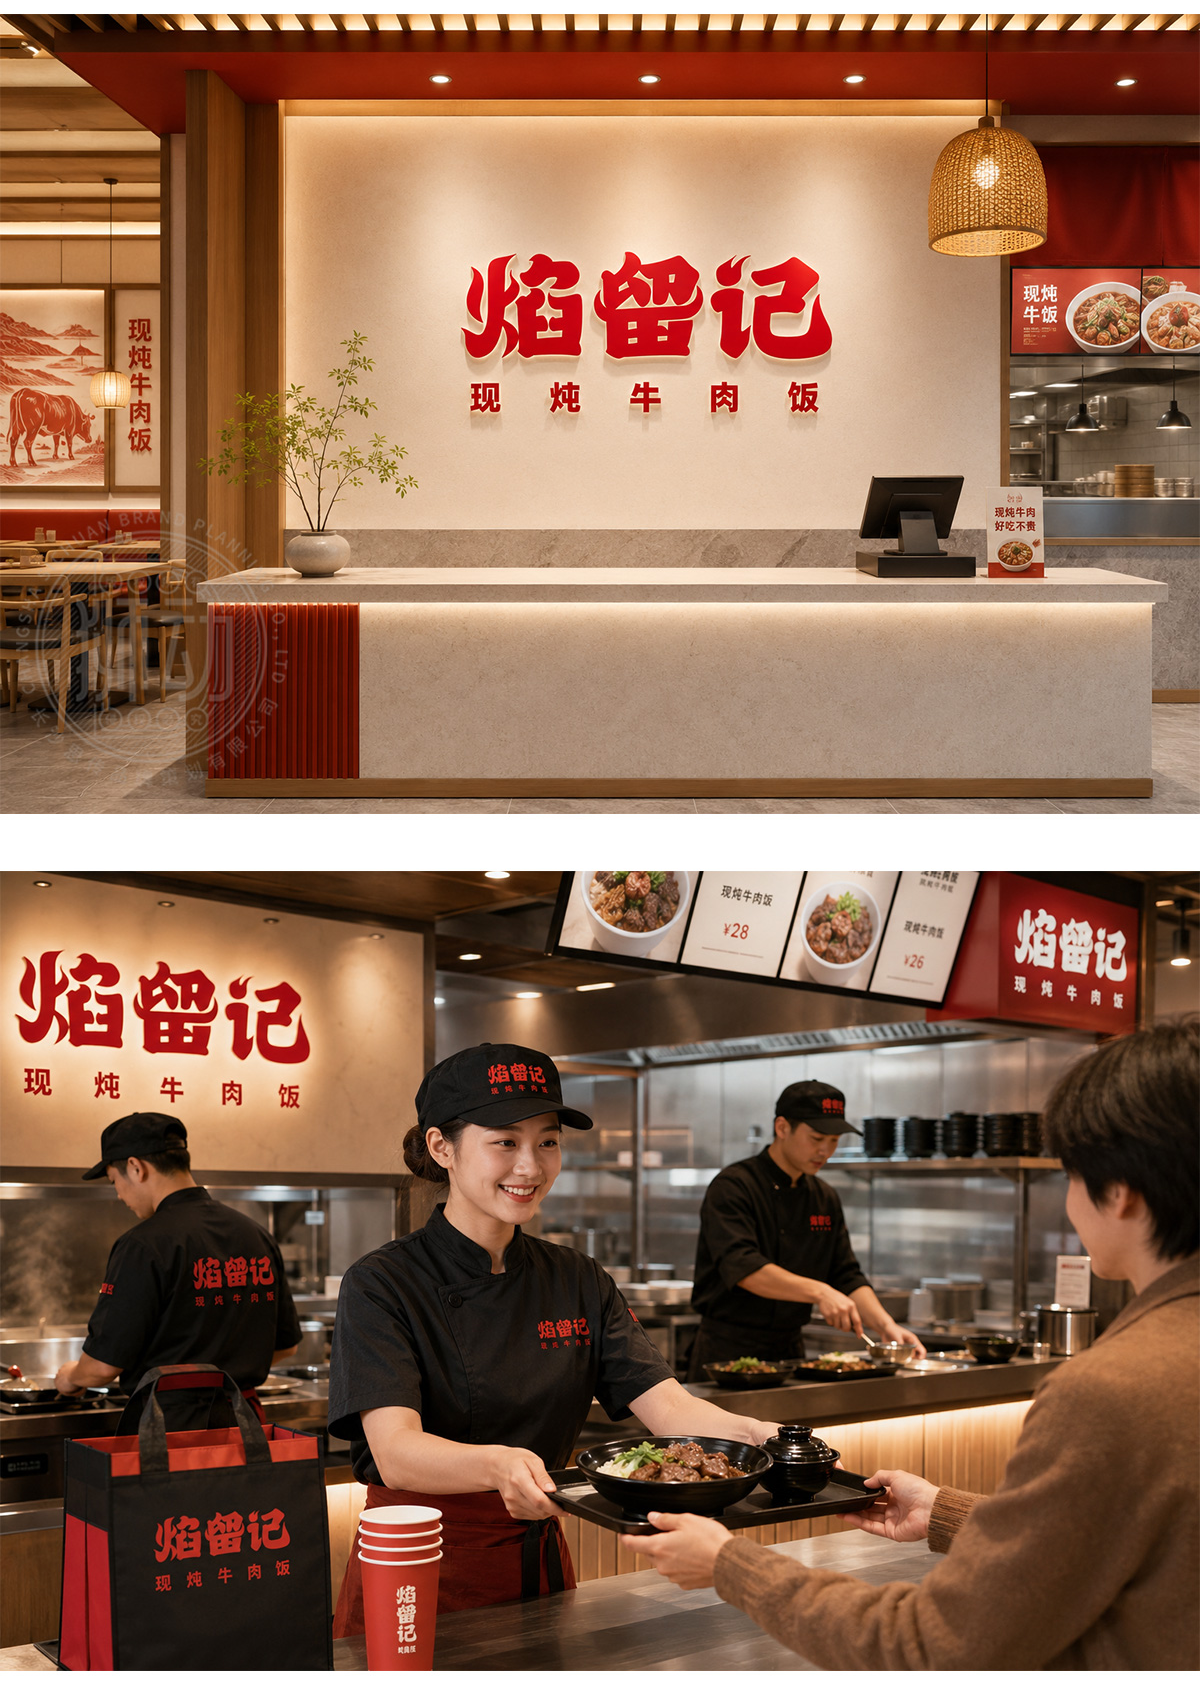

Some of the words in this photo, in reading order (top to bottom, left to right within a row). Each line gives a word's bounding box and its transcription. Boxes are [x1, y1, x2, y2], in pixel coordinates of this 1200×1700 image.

[461, 252, 832, 359] 焰留记
[1024, 285, 1057, 302] 现炖
[1023, 306, 1057, 323] 牛饭
[128, 319, 152, 452] 现炖牛肉饭
[470, 382, 818, 412] 现炖牛肉饭
[995, 507, 1035, 517] 现炖牛肉
[995, 521, 1035, 531] 好吃不贵
[721, 885, 772, 906] 现炖牛肉饭
[724, 923, 749, 939] ¥28
[904, 921, 944, 939] 现炖牛肉饭
[1015, 909, 1127, 981] 焰留记
[905, 954, 924, 969] ¥26
[1014, 976, 1123, 1008] 现炖牛肉饭
[15, 950, 310, 1064] 焰留记
[488, 1063, 545, 1084] 焰留记
[24, 1068, 300, 1108] 现炖牛肉饭
[194, 1256, 274, 1289] 焰留记
[196, 1292, 274, 1306] 现炖牛肉饭
[538, 1318, 589, 1339] 焰留记
[154, 1508, 290, 1562] 焰留记
[156, 1560, 290, 1591] 现炖牛肉饭
[396, 1585, 416, 1642] 焰留记
